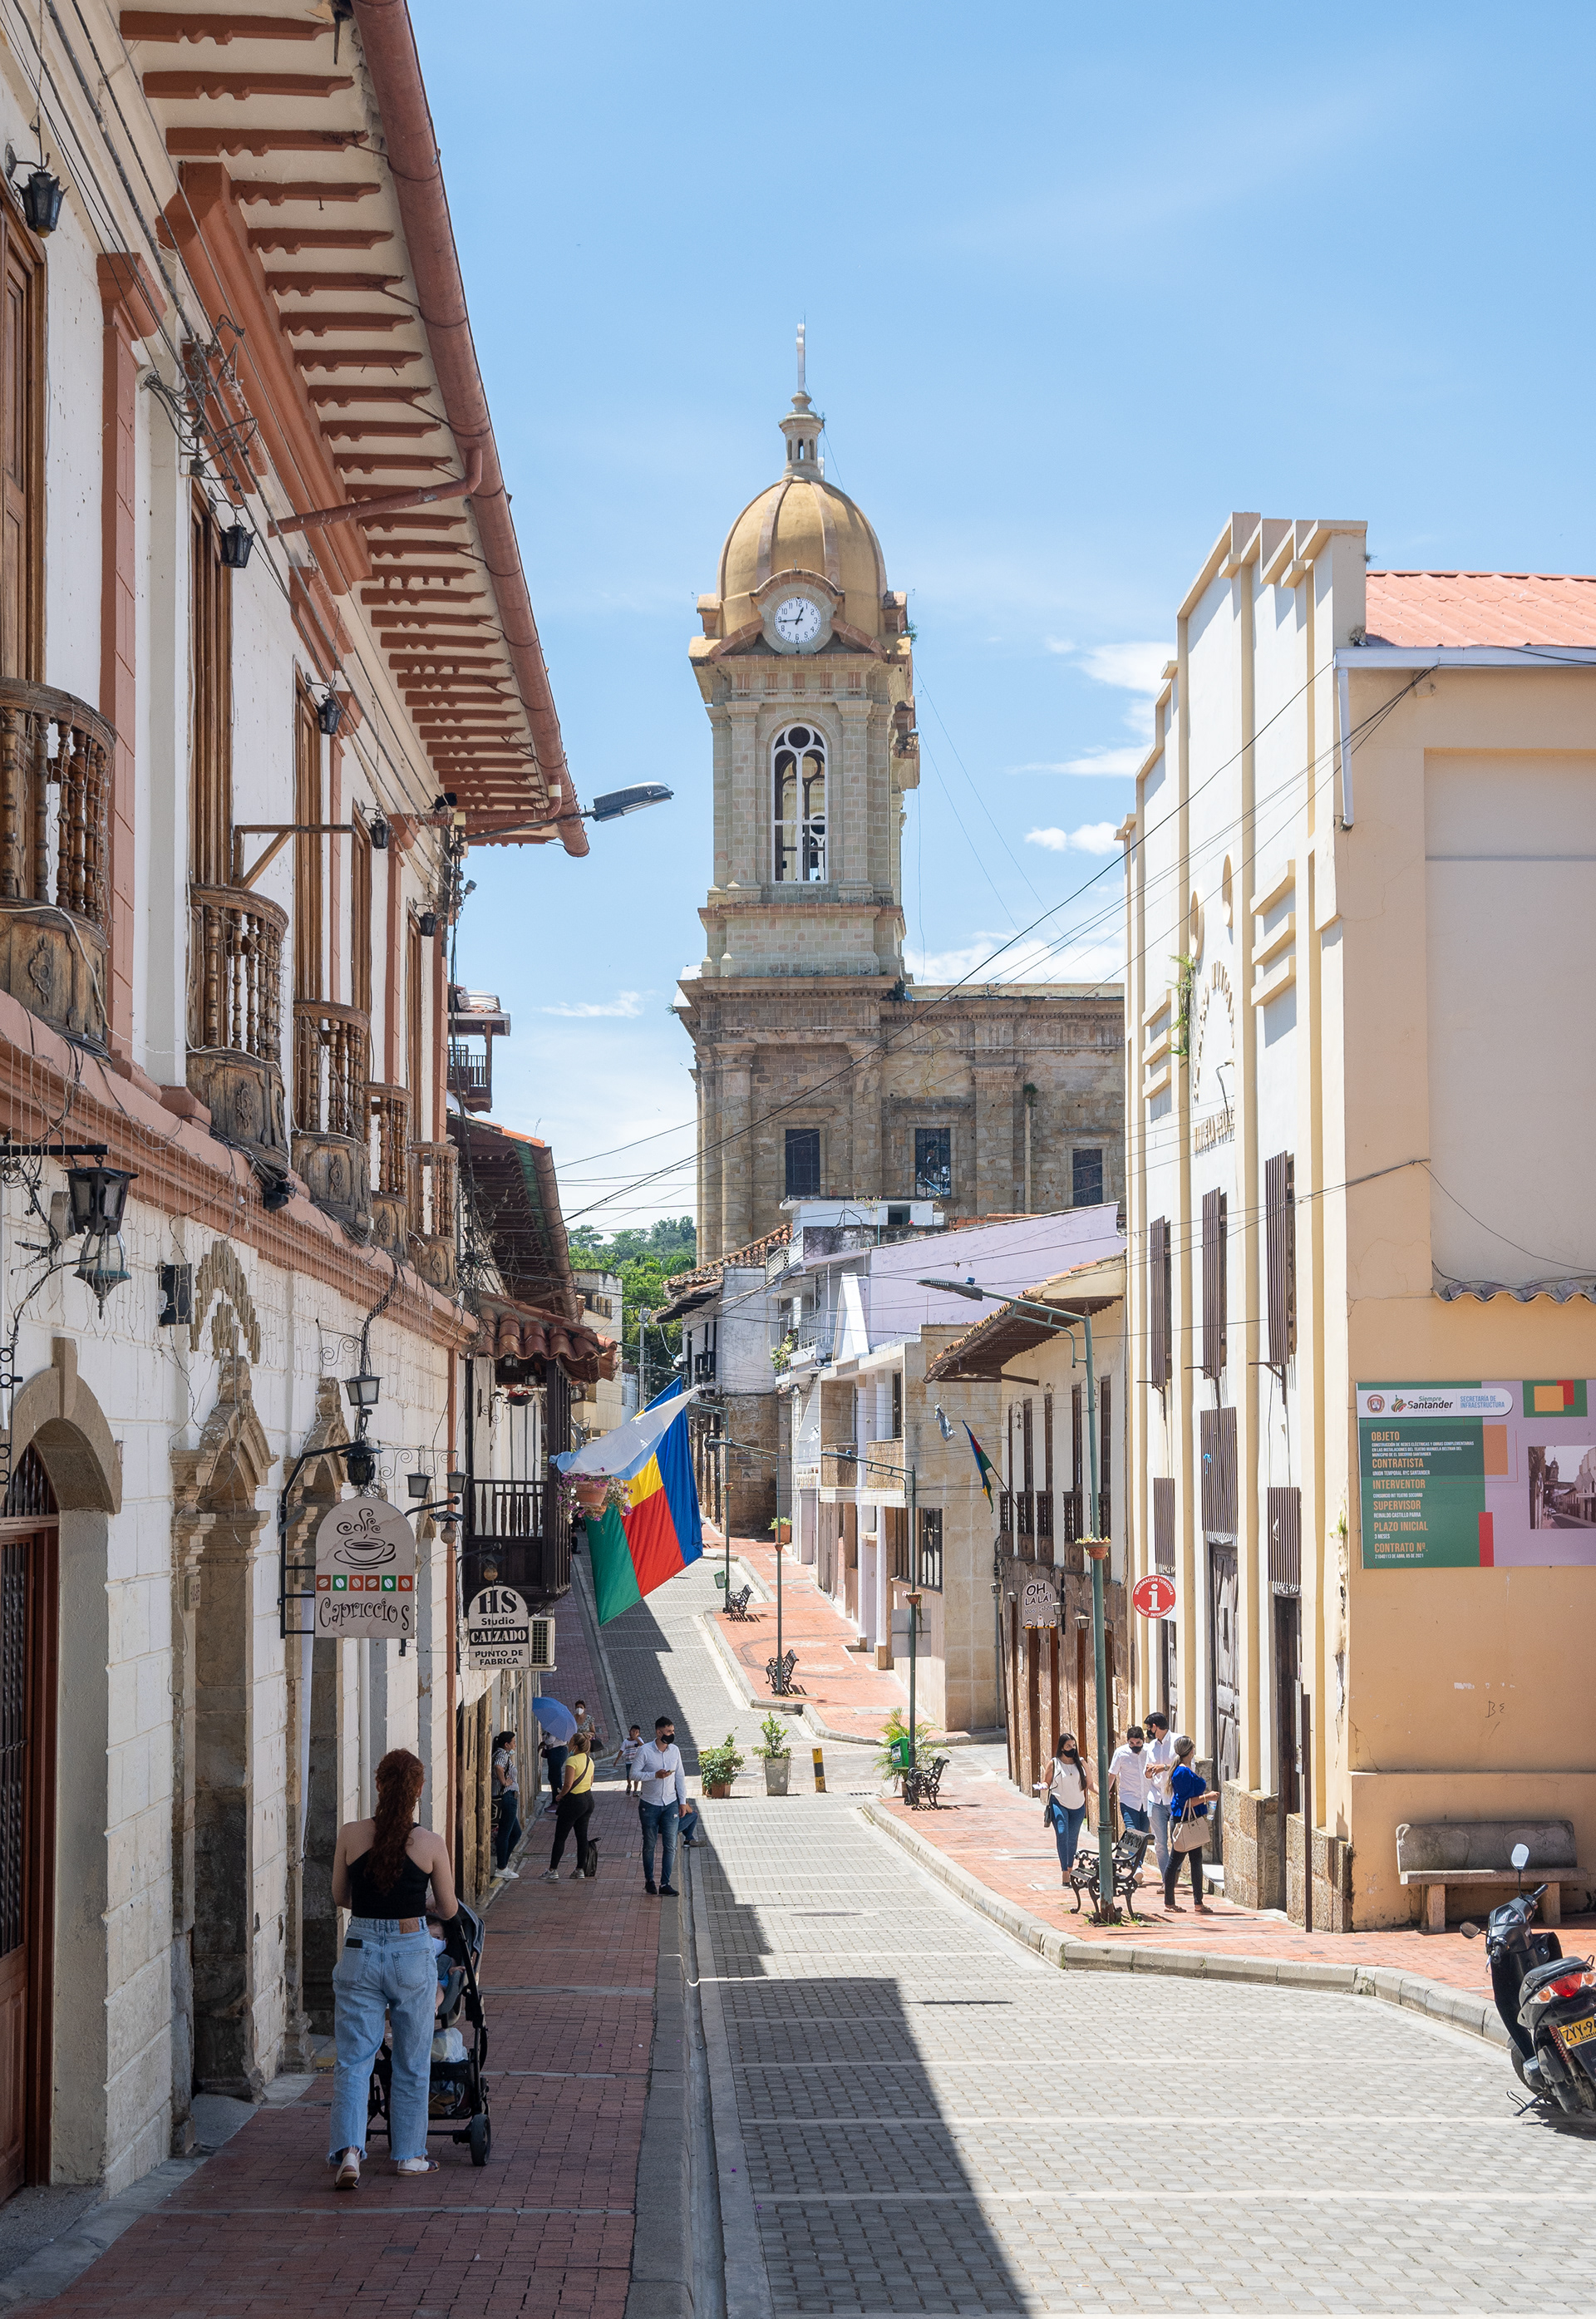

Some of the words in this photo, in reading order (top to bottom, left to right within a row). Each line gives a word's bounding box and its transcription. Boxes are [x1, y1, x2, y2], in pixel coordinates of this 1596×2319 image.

[1407, 1400, 1453, 1410] Santander
[1372, 1431, 1400, 1441] OBJETO
[1372, 1458, 1424, 1469] CONTRATISTA
[1372, 1480, 1426, 1489] INTERVENTOR
[1373, 1500, 1421, 1510] SUPERVISOR
[1373, 1522, 1398, 1532] PLAZO
[1401, 1521, 1429, 1531] INICIAL
[1374, 1543, 1414, 1553] CONTRATO
[1027, 1583, 1046, 1596] OH
[1135, 1577, 1159, 1595] INFORMACIÓN
[478, 1589, 517, 1614] HS
[1025, 1598, 1036, 1606] LA
[481, 1617, 515, 1626] Studio
[470, 1629, 526, 1643] CALZADO
[475, 1650, 508, 1658] PUNTO
[480, 1657, 519, 1666] FABRICA
